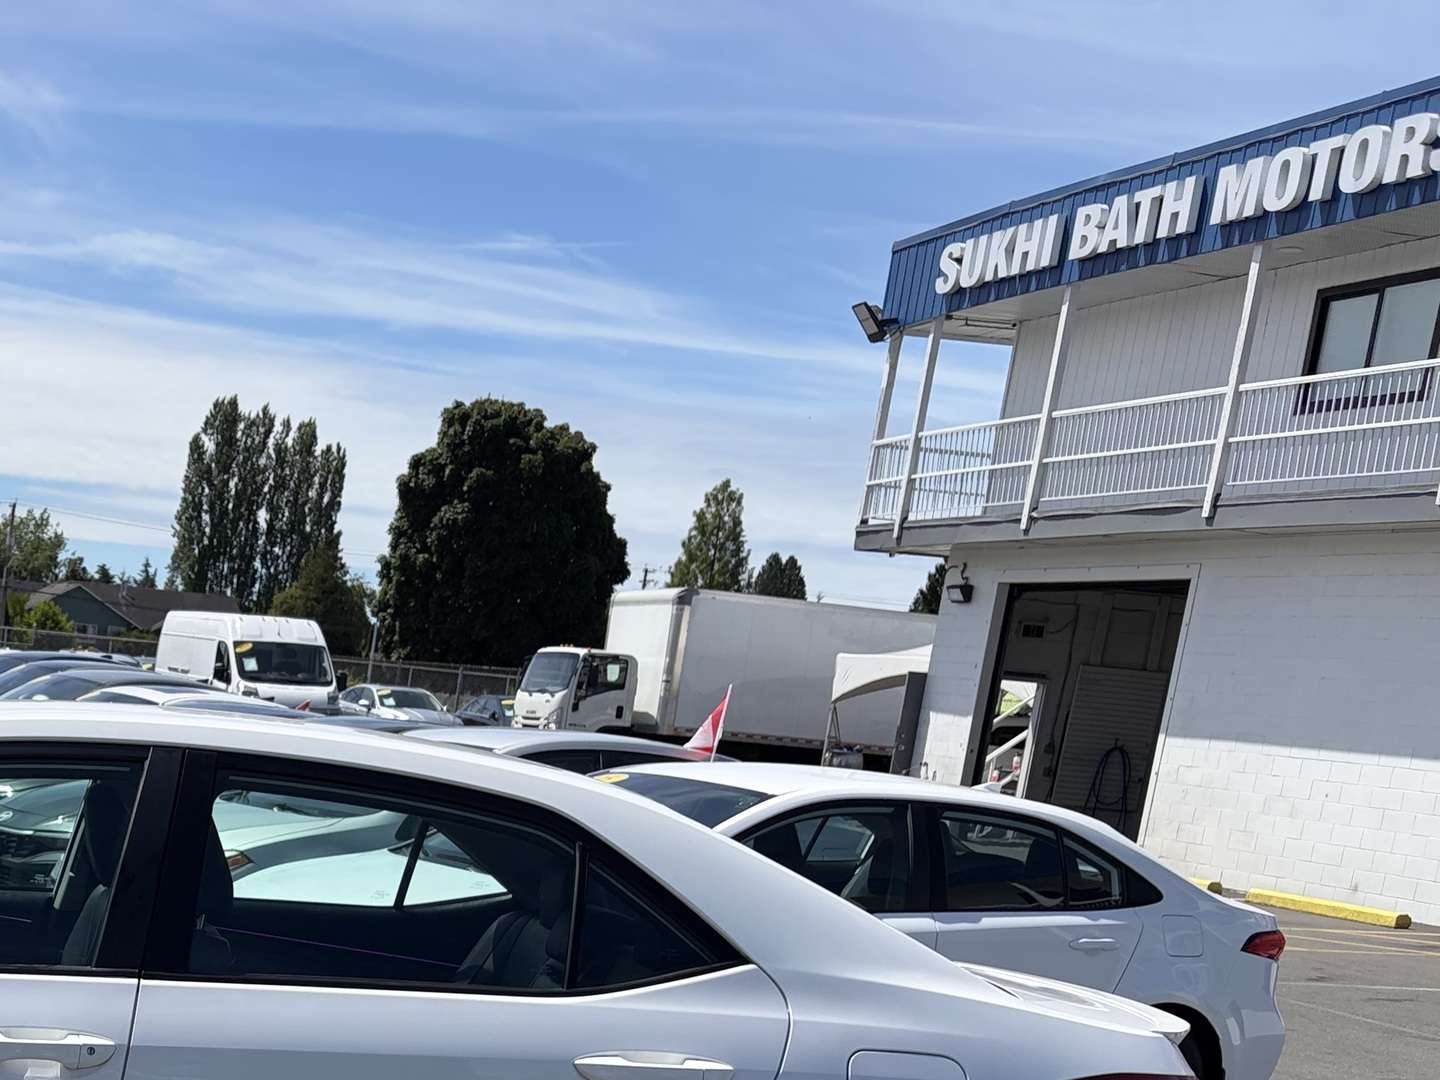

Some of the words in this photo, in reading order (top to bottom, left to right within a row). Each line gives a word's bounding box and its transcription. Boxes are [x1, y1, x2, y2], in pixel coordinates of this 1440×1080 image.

[935, 214, 1064, 295] SUKHI
[1068, 175, 1201, 261] BATH
[1210, 112, 1440, 226] MOTOR
